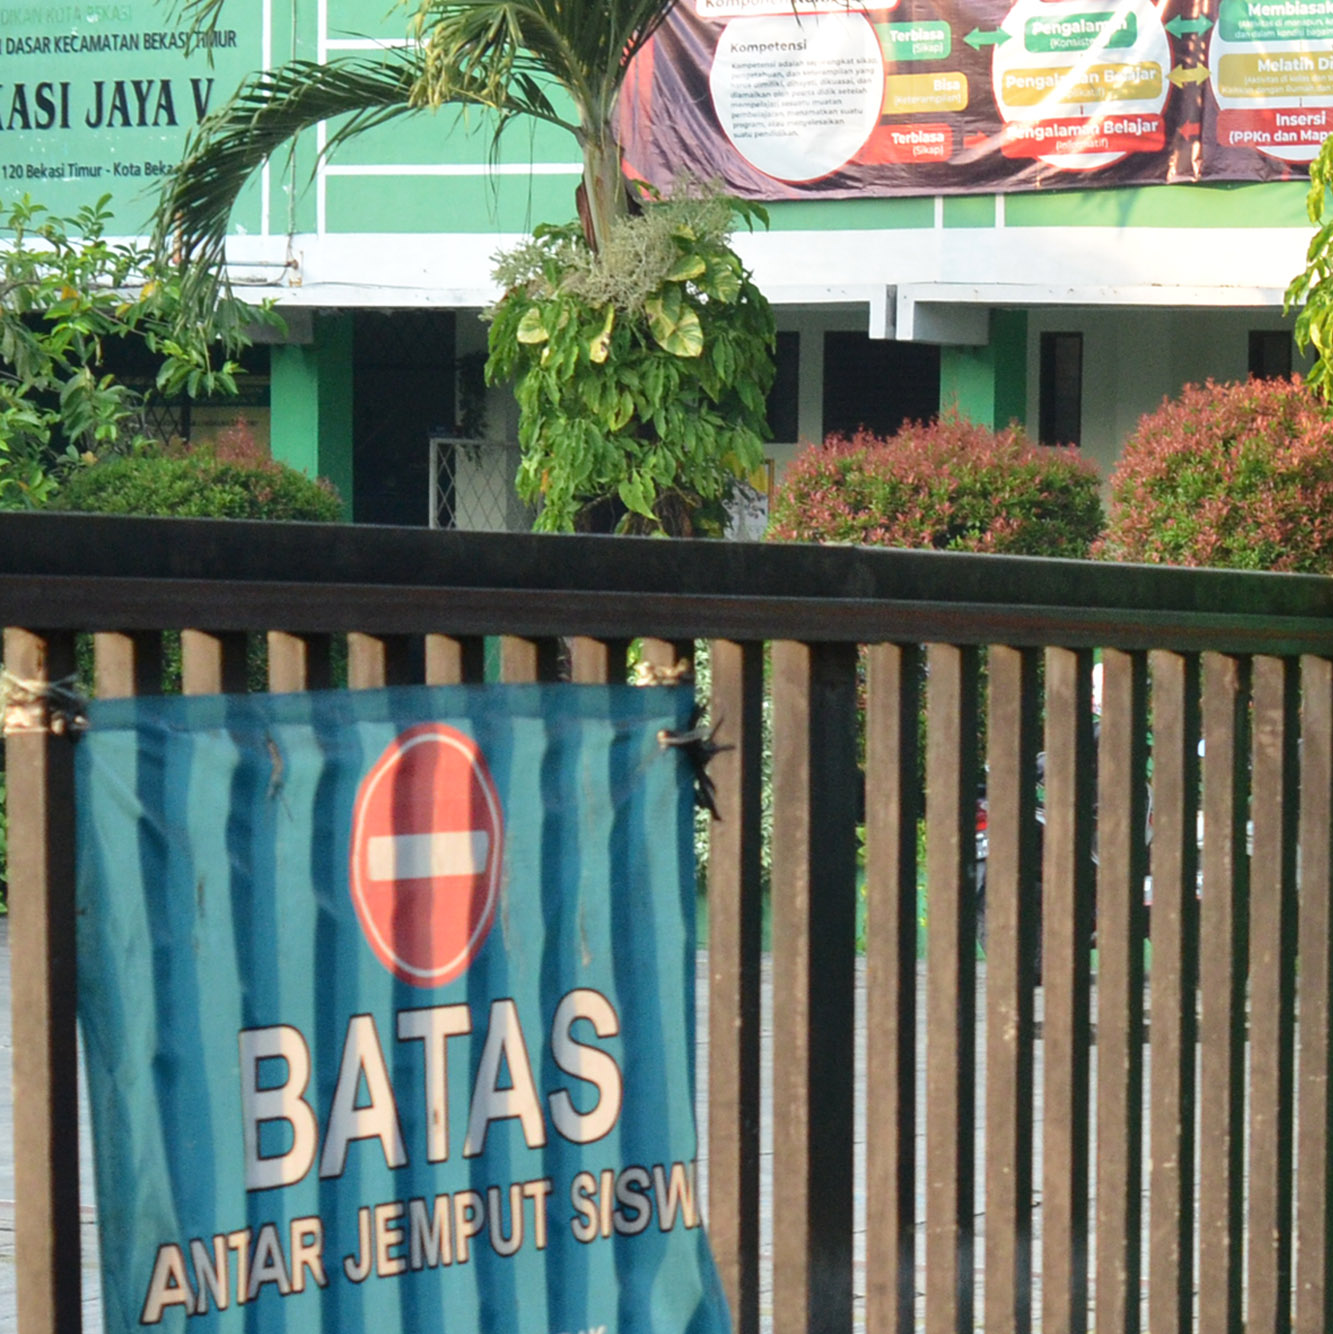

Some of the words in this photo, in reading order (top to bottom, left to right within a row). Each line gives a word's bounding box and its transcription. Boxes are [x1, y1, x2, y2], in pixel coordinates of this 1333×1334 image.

[890, 28, 944, 42] Terbiasa
[1032, 18, 1127, 36] Pengalan
[6, 36, 51, 55] DASAR
[54, 33, 139, 53] KECAMATAN
[144, 31, 190, 50] BEKASI
[730, 39, 807, 54] Kompetensi
[1258, 56, 1314, 72] Melatih
[933, 79, 960, 92] Bisa
[85, 78, 178, 129] JAYA
[1276, 111, 1326, 126] Insersi
[1006, 123, 1099, 142] Pengalaman
[1104, 117, 1159, 136] Belajar
[1229, 130, 1271, 145] (PPKn
[1274, 130, 1297, 142] dan
[1300, 129, 1333, 144] Map
[891, 131, 945, 145] Terbiasa
[912, 145, 944, 157] (Sikap)
[2, 164, 24, 180] 120
[26, 163, 65, 179] Bekasi
[67, 163, 102, 178] Timur
[113, 162, 141, 177] Kota
[238, 987, 622, 1191] BATAS
[139, 1214, 329, 1326] ANTAR
[343, 1177, 552, 1284] JEMPUT
